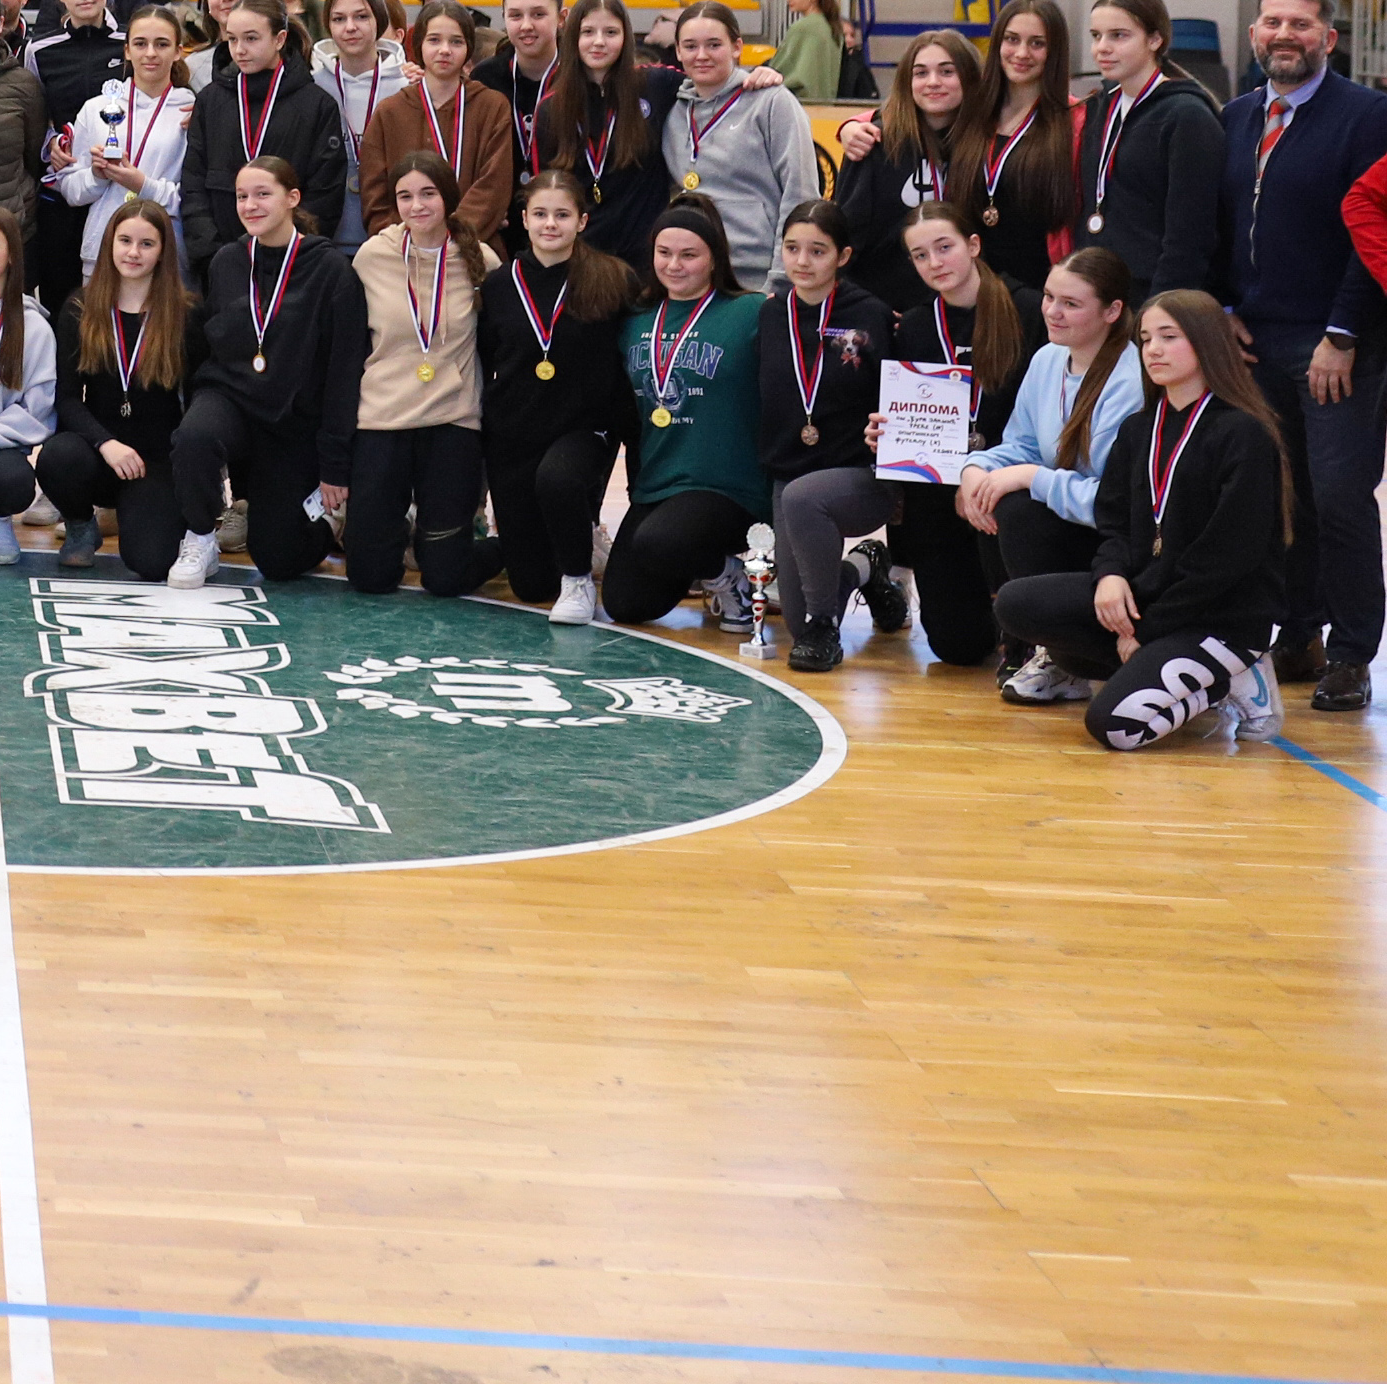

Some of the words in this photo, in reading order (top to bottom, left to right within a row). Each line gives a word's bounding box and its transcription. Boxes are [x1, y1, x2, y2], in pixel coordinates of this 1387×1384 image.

[629, 341, 724, 379] MICIGAN
[889, 401, 959, 416] ДИПЛОМА
[23, 578, 391, 833] MAXBET
